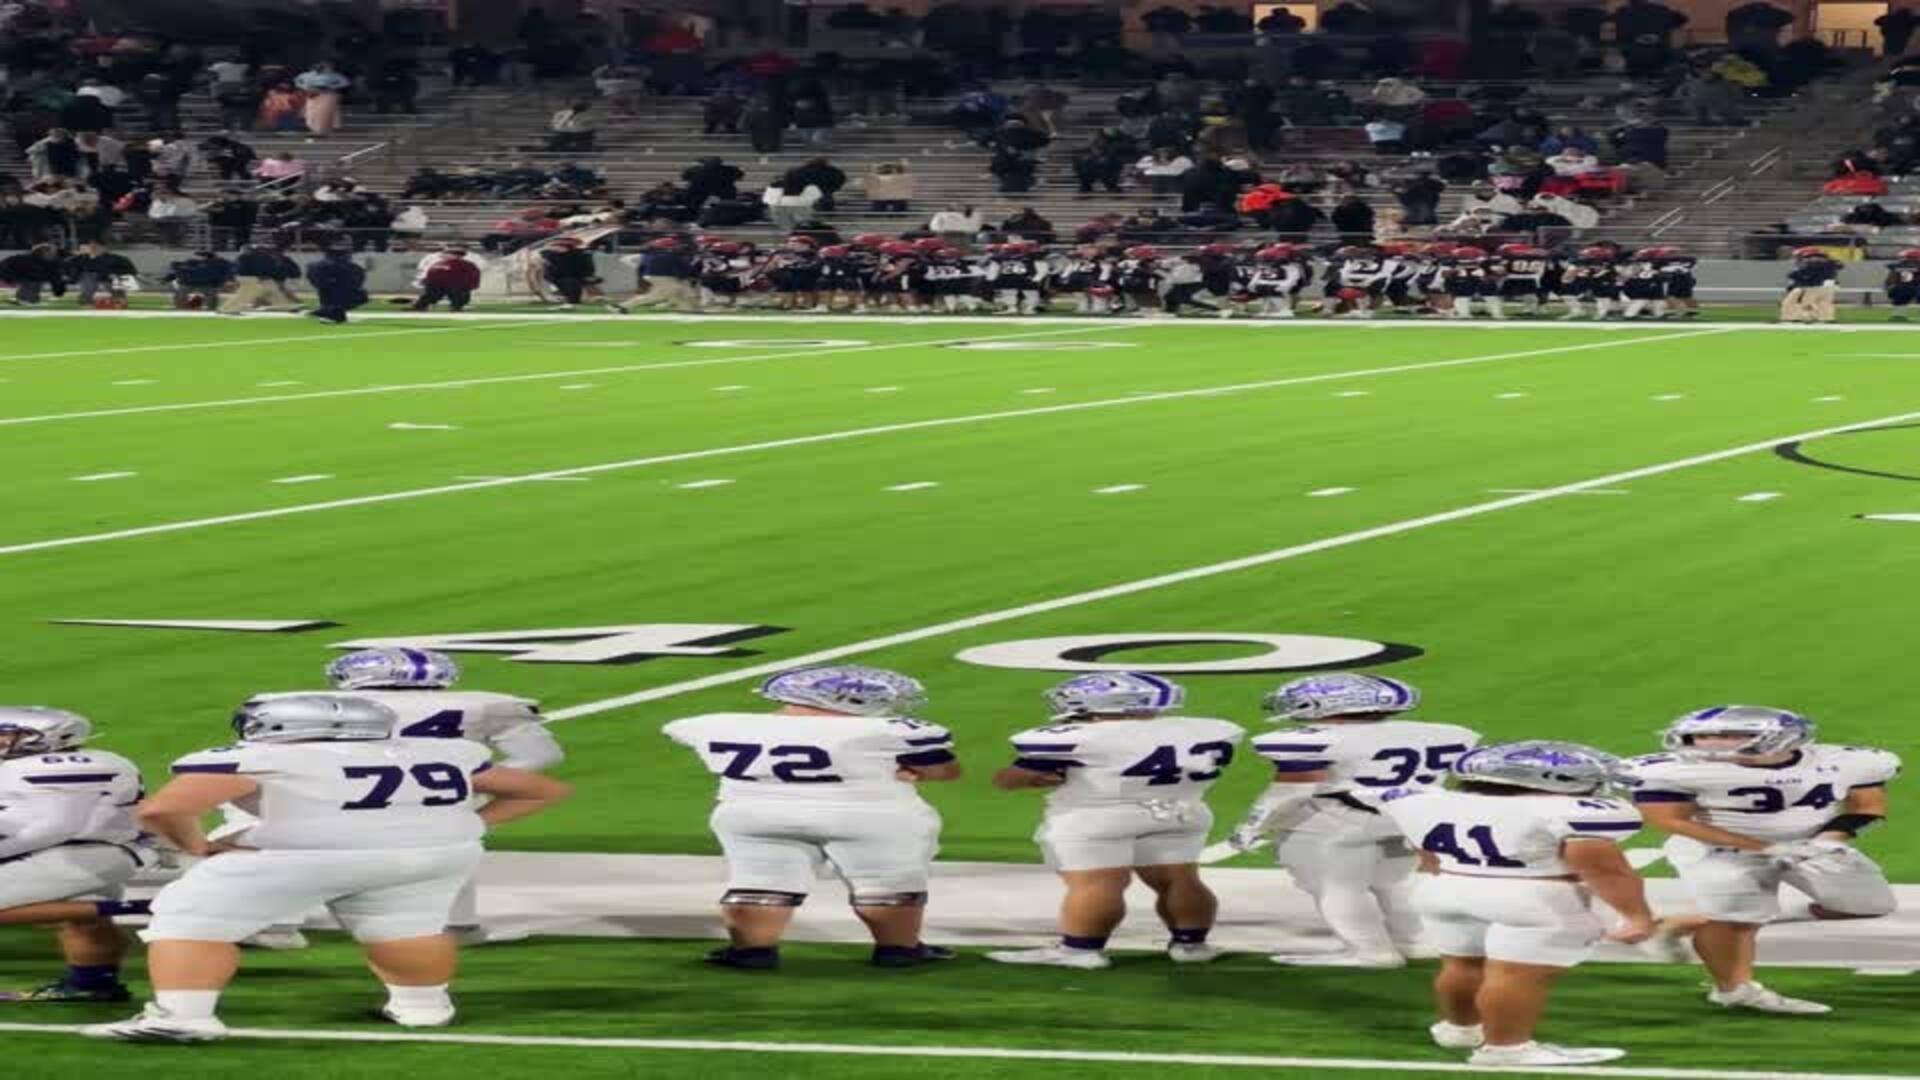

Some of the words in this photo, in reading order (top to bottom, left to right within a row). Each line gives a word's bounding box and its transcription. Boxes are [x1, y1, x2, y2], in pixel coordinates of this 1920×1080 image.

[709, 741, 843, 783] 72
[1120, 741, 1235, 786] 43
[1353, 743, 1468, 787] 35
[341, 762, 469, 810] 79
[1727, 783, 1836, 813] 34
[1422, 823, 1527, 868] 41
